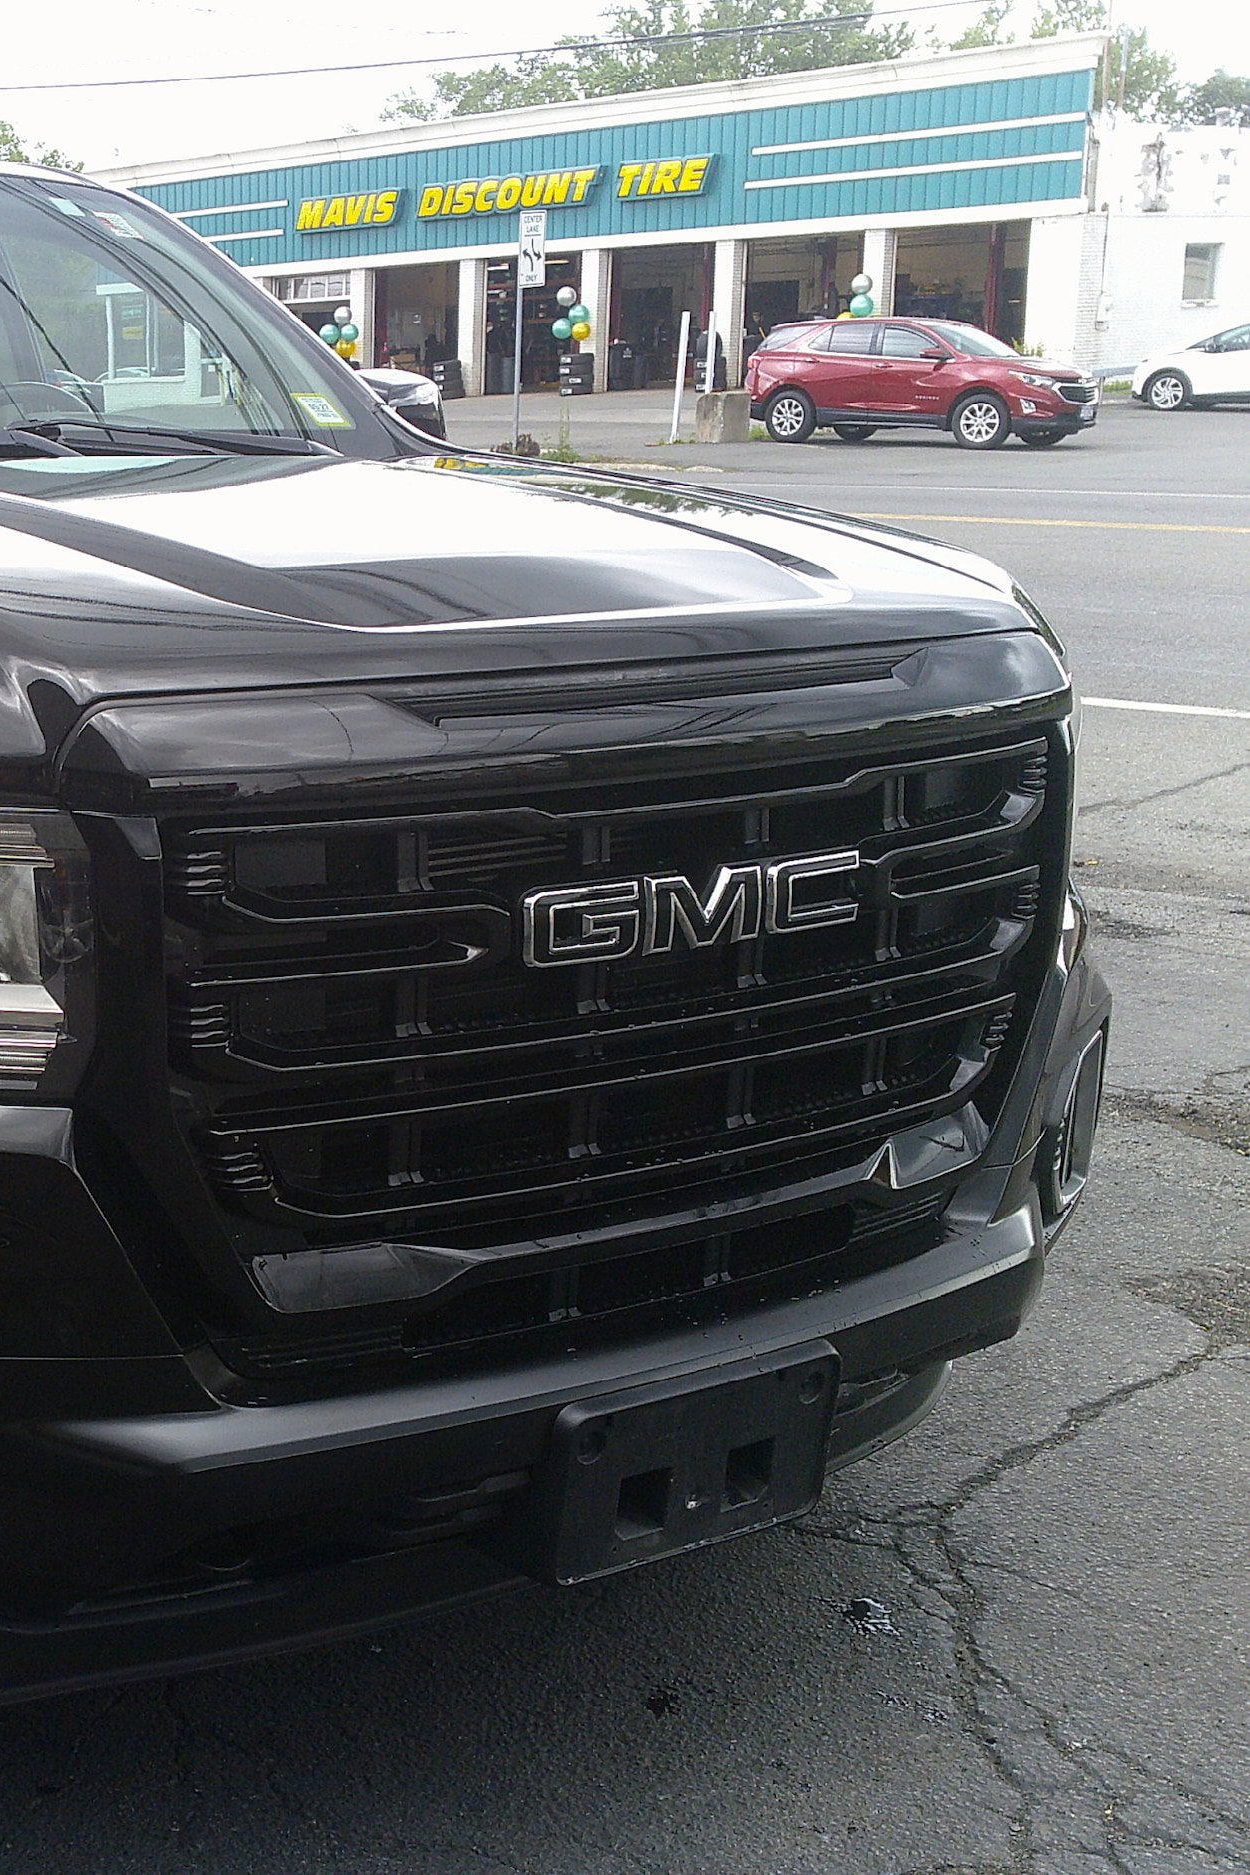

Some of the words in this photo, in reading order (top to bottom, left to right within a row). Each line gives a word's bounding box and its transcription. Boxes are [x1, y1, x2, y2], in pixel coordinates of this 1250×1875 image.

[295, 190, 399, 230] MAVIS
[416, 168, 598, 219] DISCOUNT
[616, 157, 711, 199] TIRE
[523, 214, 543, 224] CENTER
[525, 273, 538, 282] ONLY
[523, 849, 861, 969] GMC
